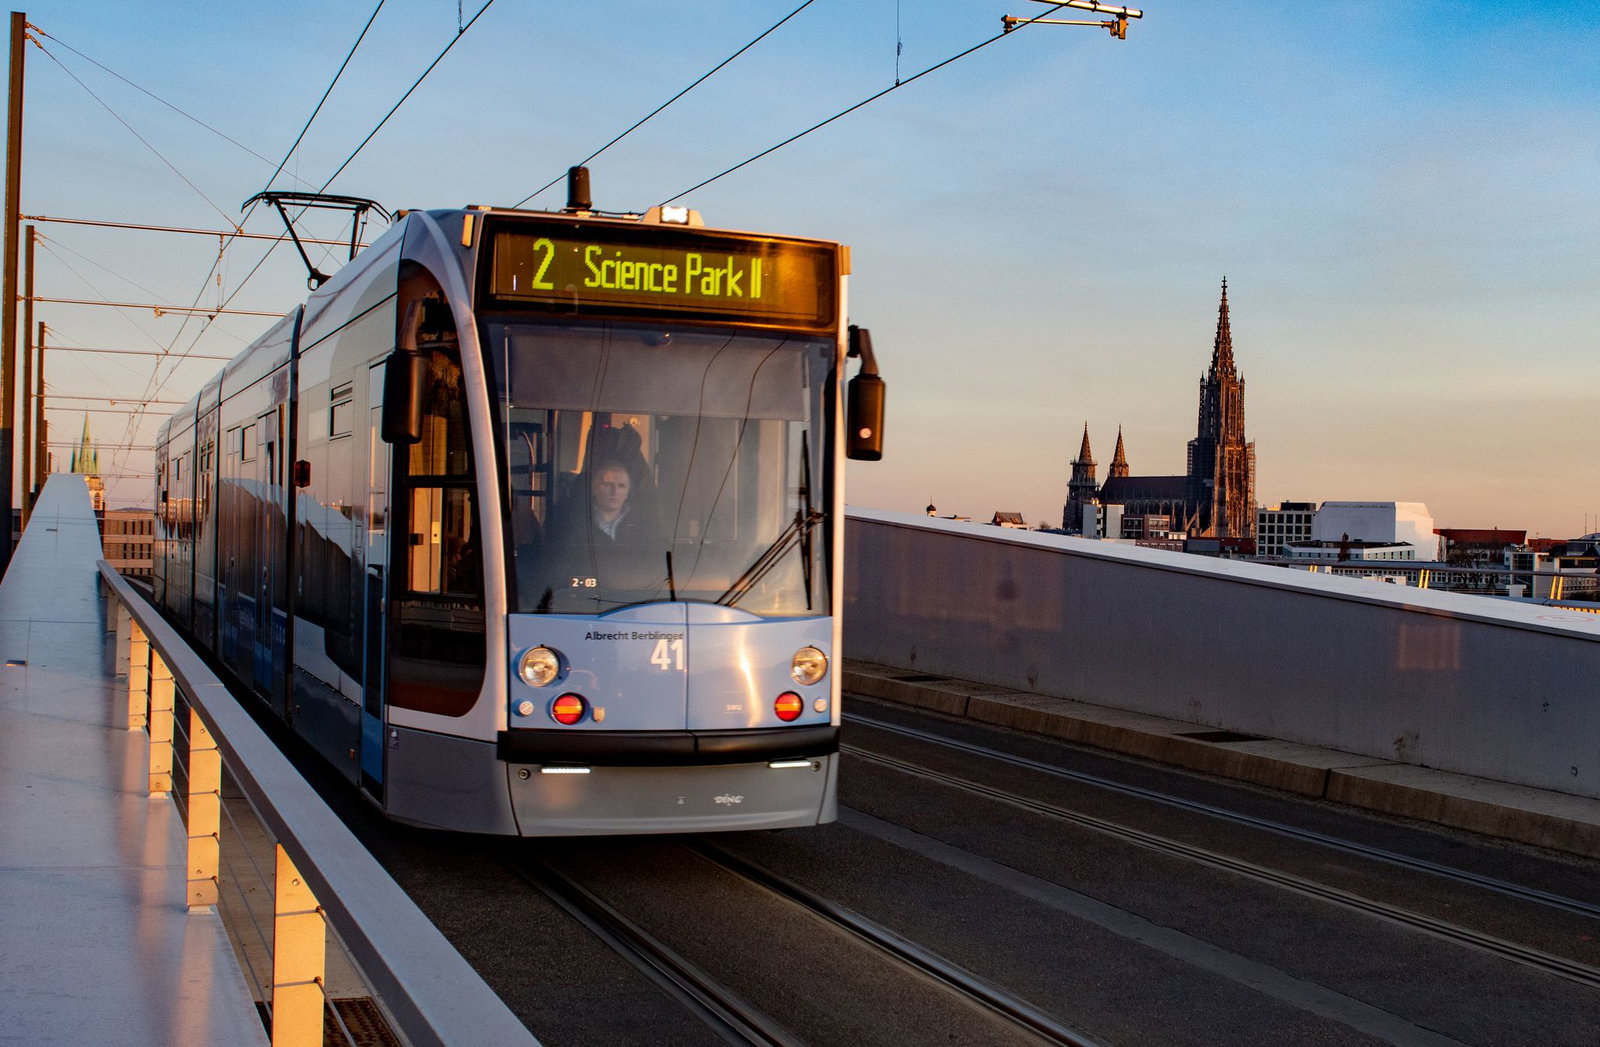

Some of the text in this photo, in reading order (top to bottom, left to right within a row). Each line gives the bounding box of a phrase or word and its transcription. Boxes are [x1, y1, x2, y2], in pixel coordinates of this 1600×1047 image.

[531, 237, 556, 291] 2
[584, 245, 678, 293] Science
[685, 252, 743, 298] Park
[584, 630, 684, 643] Albrecht Berblinger
[650, 638, 684, 671] 41
